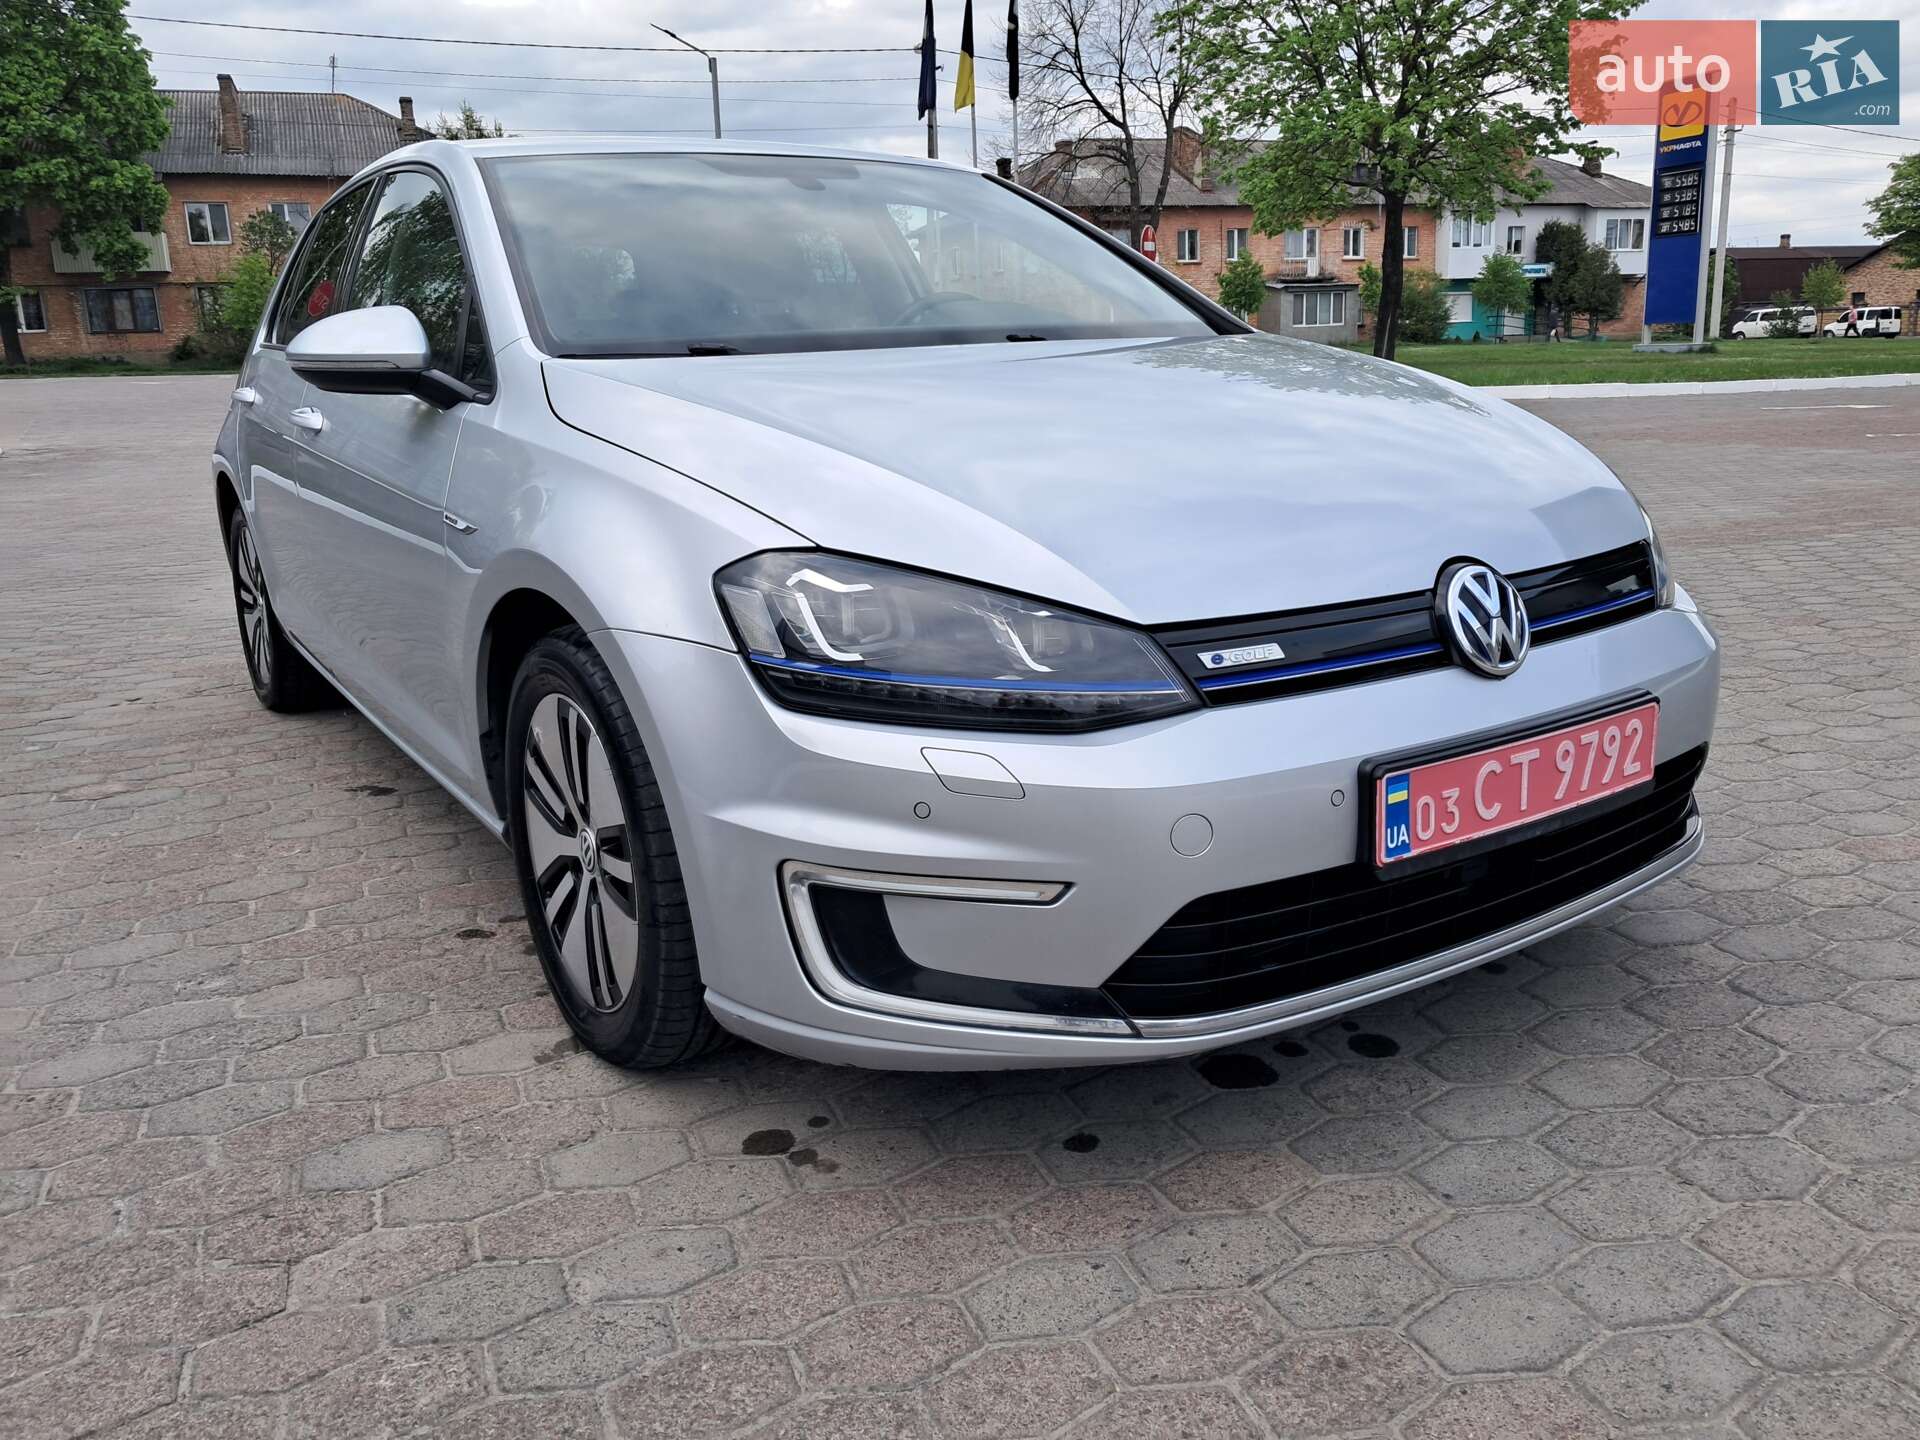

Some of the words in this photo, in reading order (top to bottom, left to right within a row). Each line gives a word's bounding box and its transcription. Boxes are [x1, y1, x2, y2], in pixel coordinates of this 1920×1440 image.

[1659, 140, 1703, 153] УКРНАФТА
[1416, 788, 1460, 841] 03
[1474, 748, 1542, 821] CT
[1554, 718, 1643, 801] 9792
[1387, 824, 1410, 849] UA
